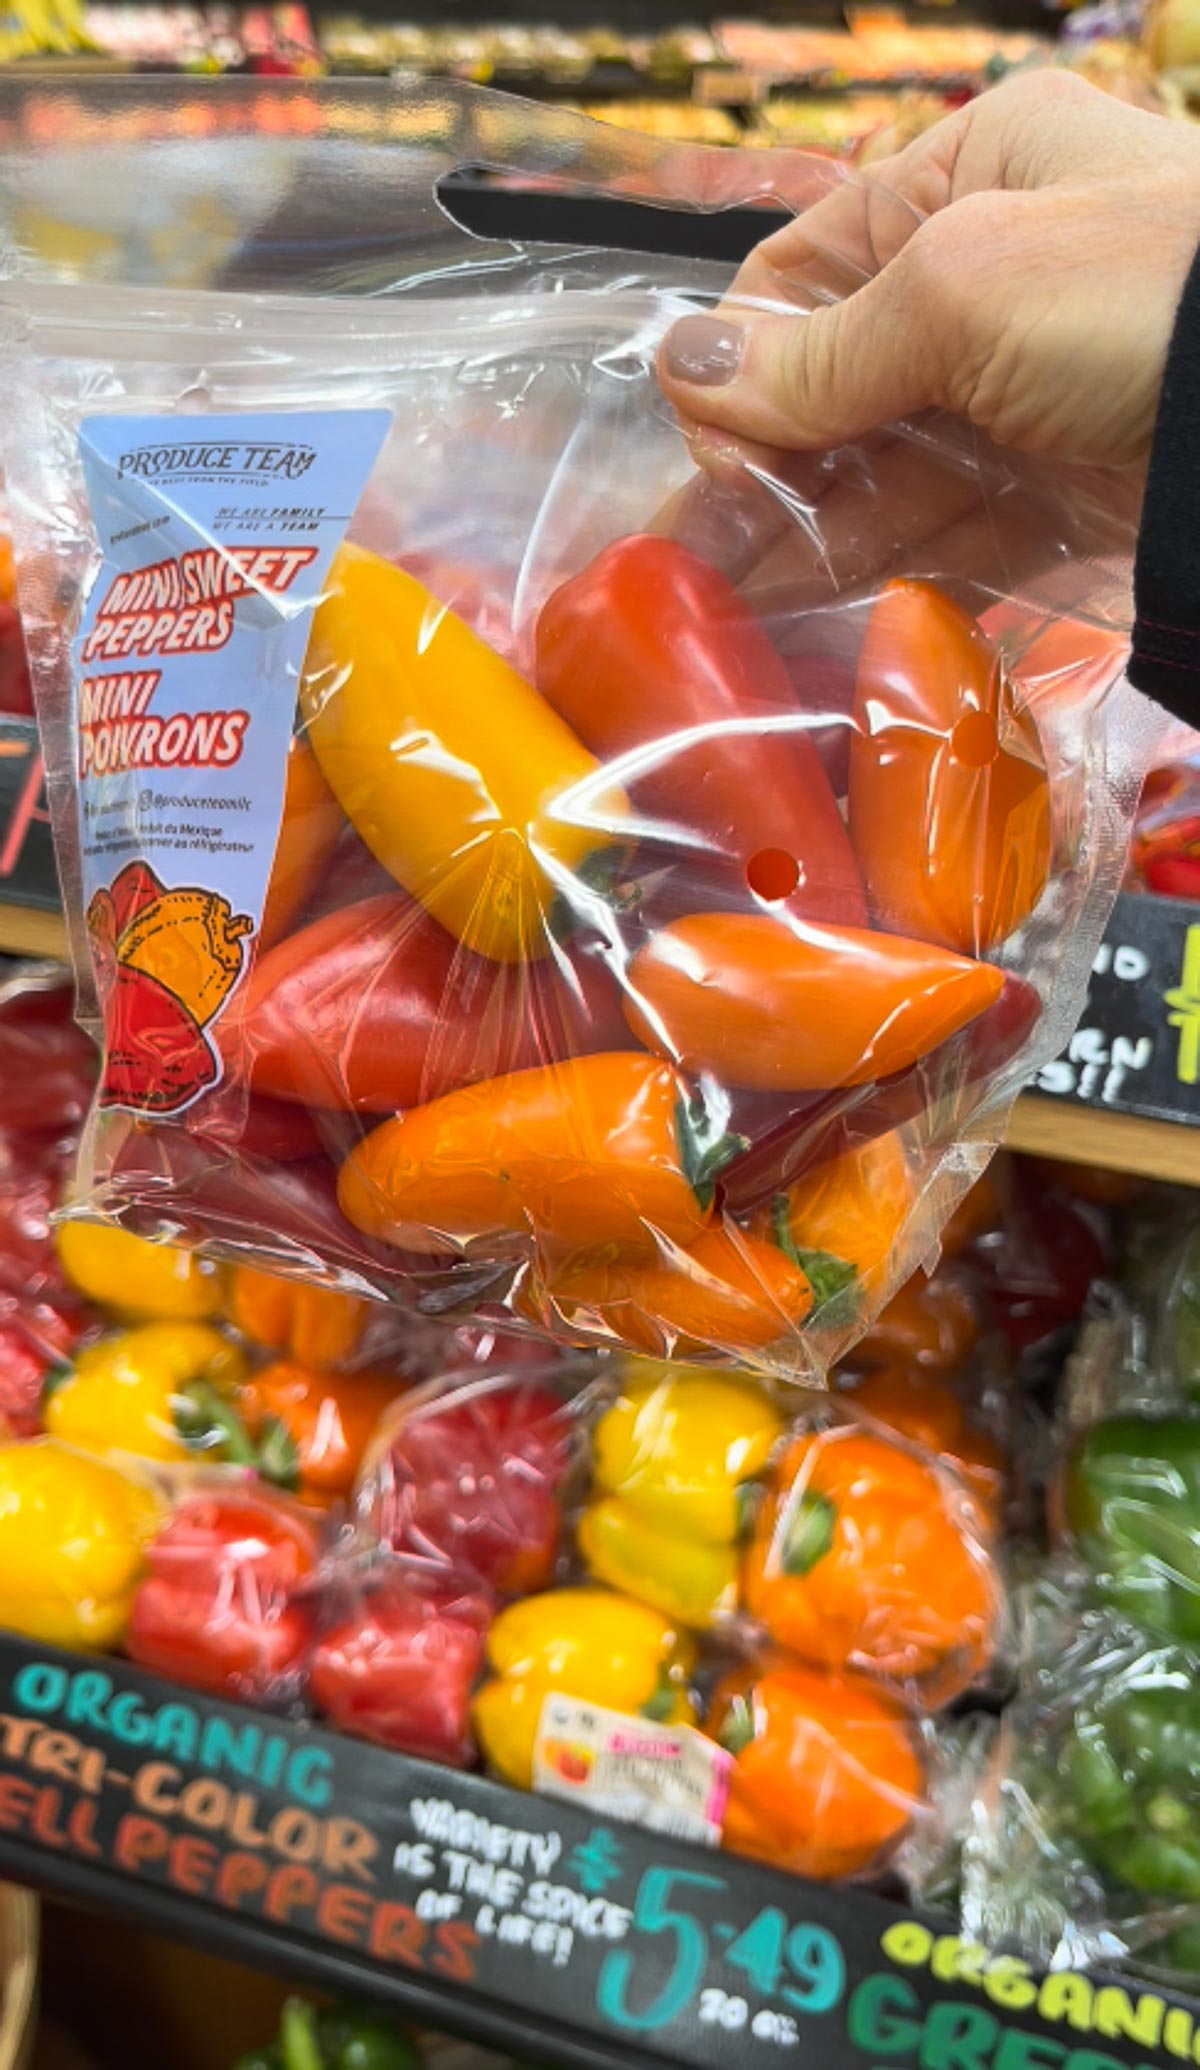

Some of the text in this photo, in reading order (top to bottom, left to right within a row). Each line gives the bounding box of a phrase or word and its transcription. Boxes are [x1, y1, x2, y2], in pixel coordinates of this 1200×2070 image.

[117, 447, 316, 480] PRODUCE TEAM
[236, 521, 259, 532] ARE
[280, 521, 320, 532] TEAM
[244, 507, 266, 518] ARE
[270, 507, 326, 519] FAMILY
[97, 546, 319, 615] MINI SWEET
[81, 601, 233, 661] PEPPERS
[80, 669, 162, 722] MINI
[79, 711, 250, 778] POIVRONS
[179, 824, 224, 840] Mexique
[13, 1662, 336, 1807] ORGANIC
[0, 1713, 379, 1883] TRI-COLOR
[410, 1797, 563, 1876] VARIETY
[110, 1813, 481, 1983] PEPPERS
[393, 1841, 635, 1941] IS THE SPICE
[415, 1888, 463, 1922] OF
[698, 1988, 748, 2030] 20
[880, 1921, 1200, 2064] ORGANI
